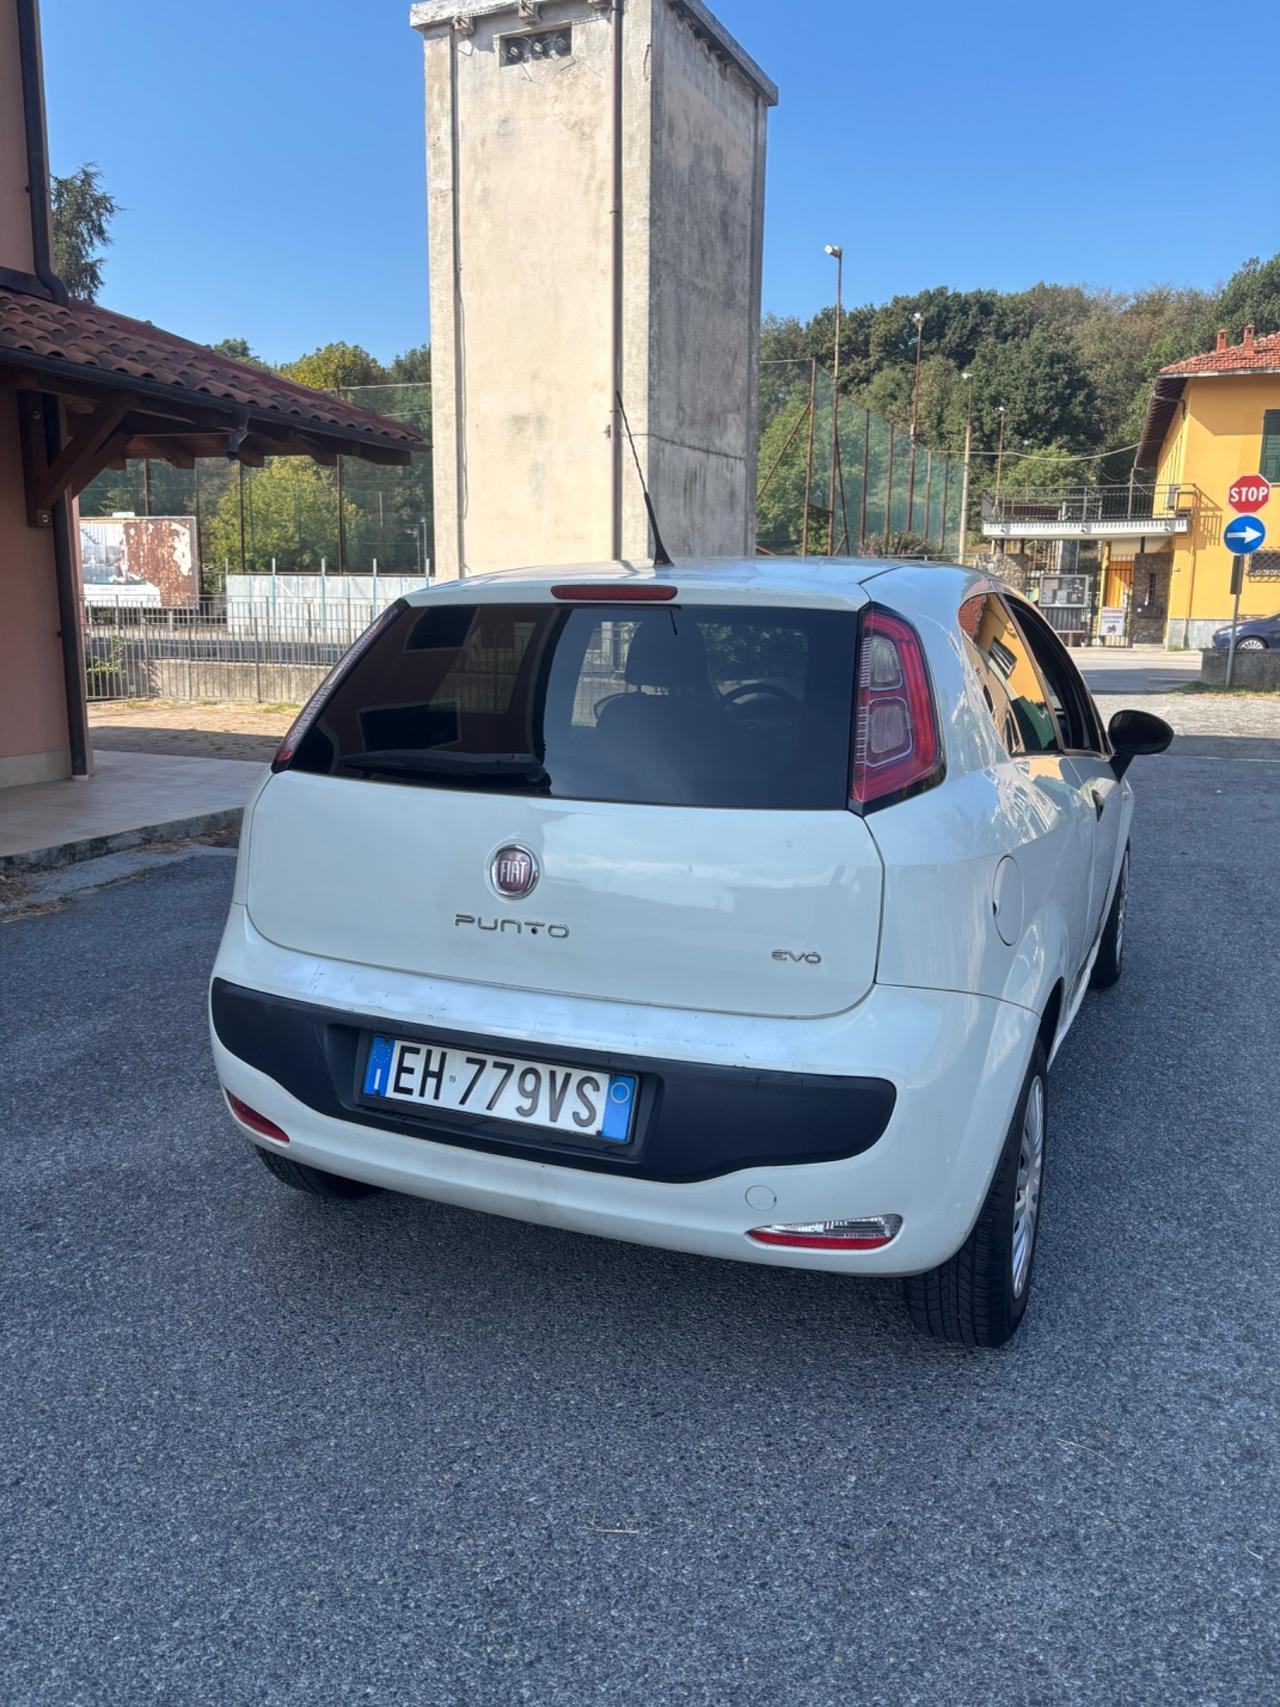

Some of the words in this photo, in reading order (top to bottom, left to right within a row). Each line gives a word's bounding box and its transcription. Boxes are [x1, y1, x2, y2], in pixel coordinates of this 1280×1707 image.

[1230, 487, 1268, 502] STOP
[500, 861, 528, 883] FIAT
[455, 914, 570, 938] PUNTO
[771, 949, 822, 964] EVO
[393, 1045, 448, 1100] EH
[458, 1057, 601, 1128] 779VS
